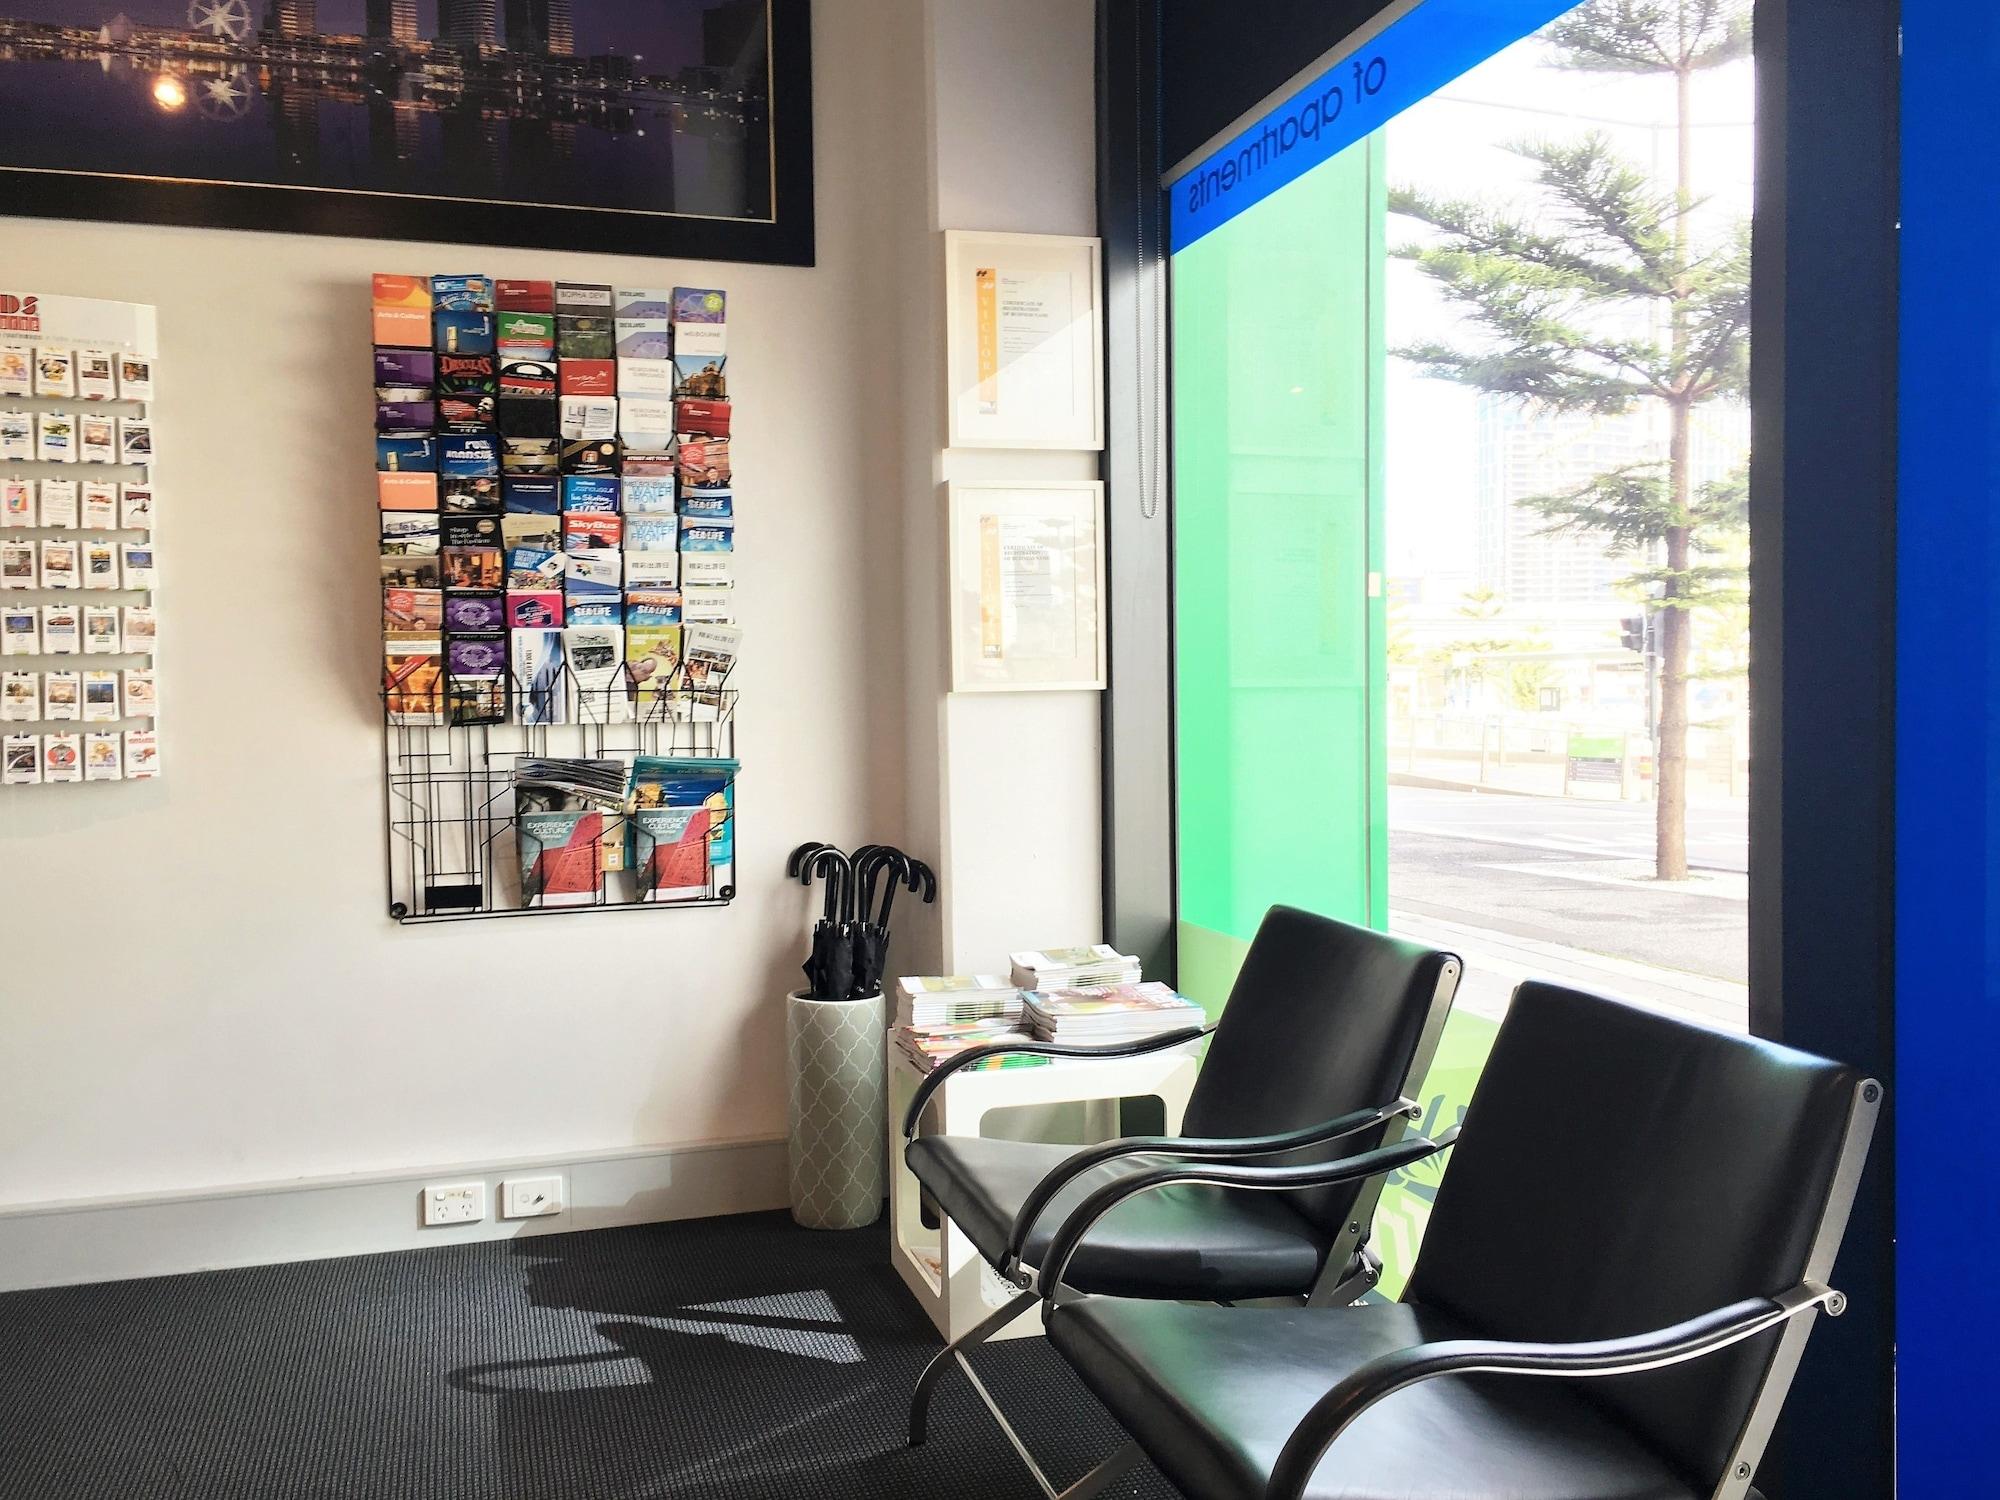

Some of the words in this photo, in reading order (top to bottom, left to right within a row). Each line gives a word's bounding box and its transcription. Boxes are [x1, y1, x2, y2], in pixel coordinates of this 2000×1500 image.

[633, 486, 673, 497] WATER
[628, 494, 664, 504] FRONT
[569, 519, 619, 531] SkyBus
[631, 532, 669, 543] FRONT
[574, 606, 593, 616] SEA
[593, 606, 612, 617] LIFE
[637, 605, 656, 615] SEA
[656, 606, 674, 617] LIFE
[642, 815, 690, 825] EXPERIENCE
[526, 820, 576, 833] EXPERIENCE
[648, 822, 685, 831] CULTURE
[532, 827, 569, 839] CULTURE
